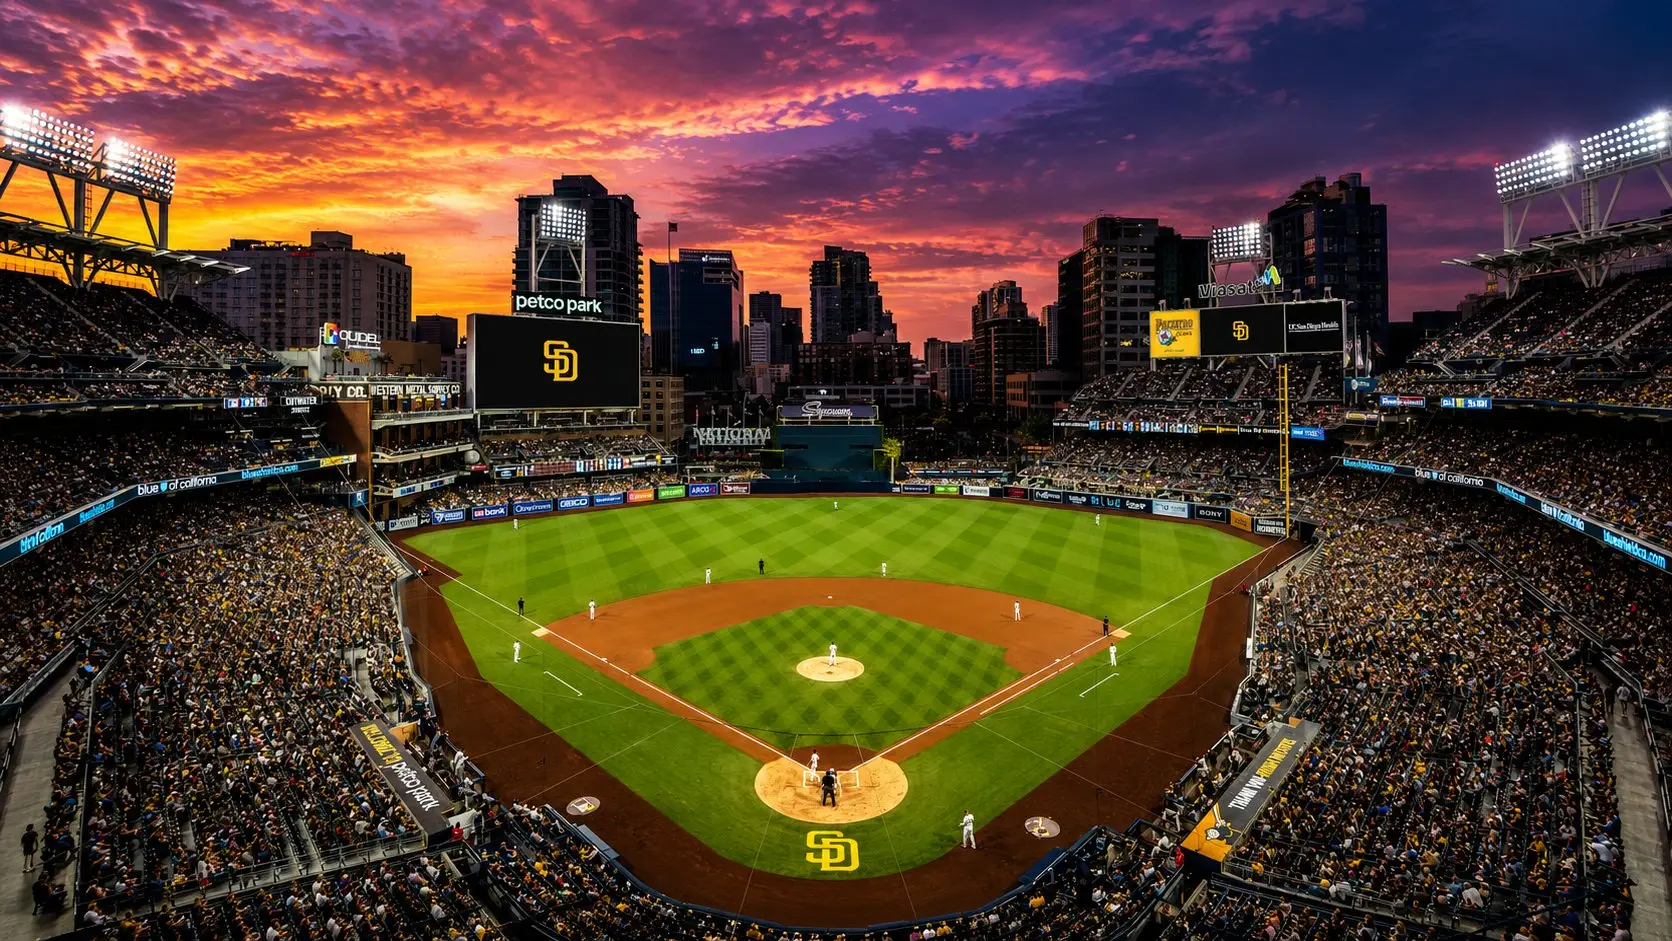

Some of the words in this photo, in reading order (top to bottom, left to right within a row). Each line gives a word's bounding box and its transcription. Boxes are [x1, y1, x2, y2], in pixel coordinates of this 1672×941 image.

[1198, 280, 1254, 299] Viasat
[516, 294, 565, 311] petco
[567, 298, 603, 315] park
[543, 339, 579, 382] SD
[137, 483, 160, 496] blue
[168, 478, 179, 491] of
[806, 830, 860, 871] SD
